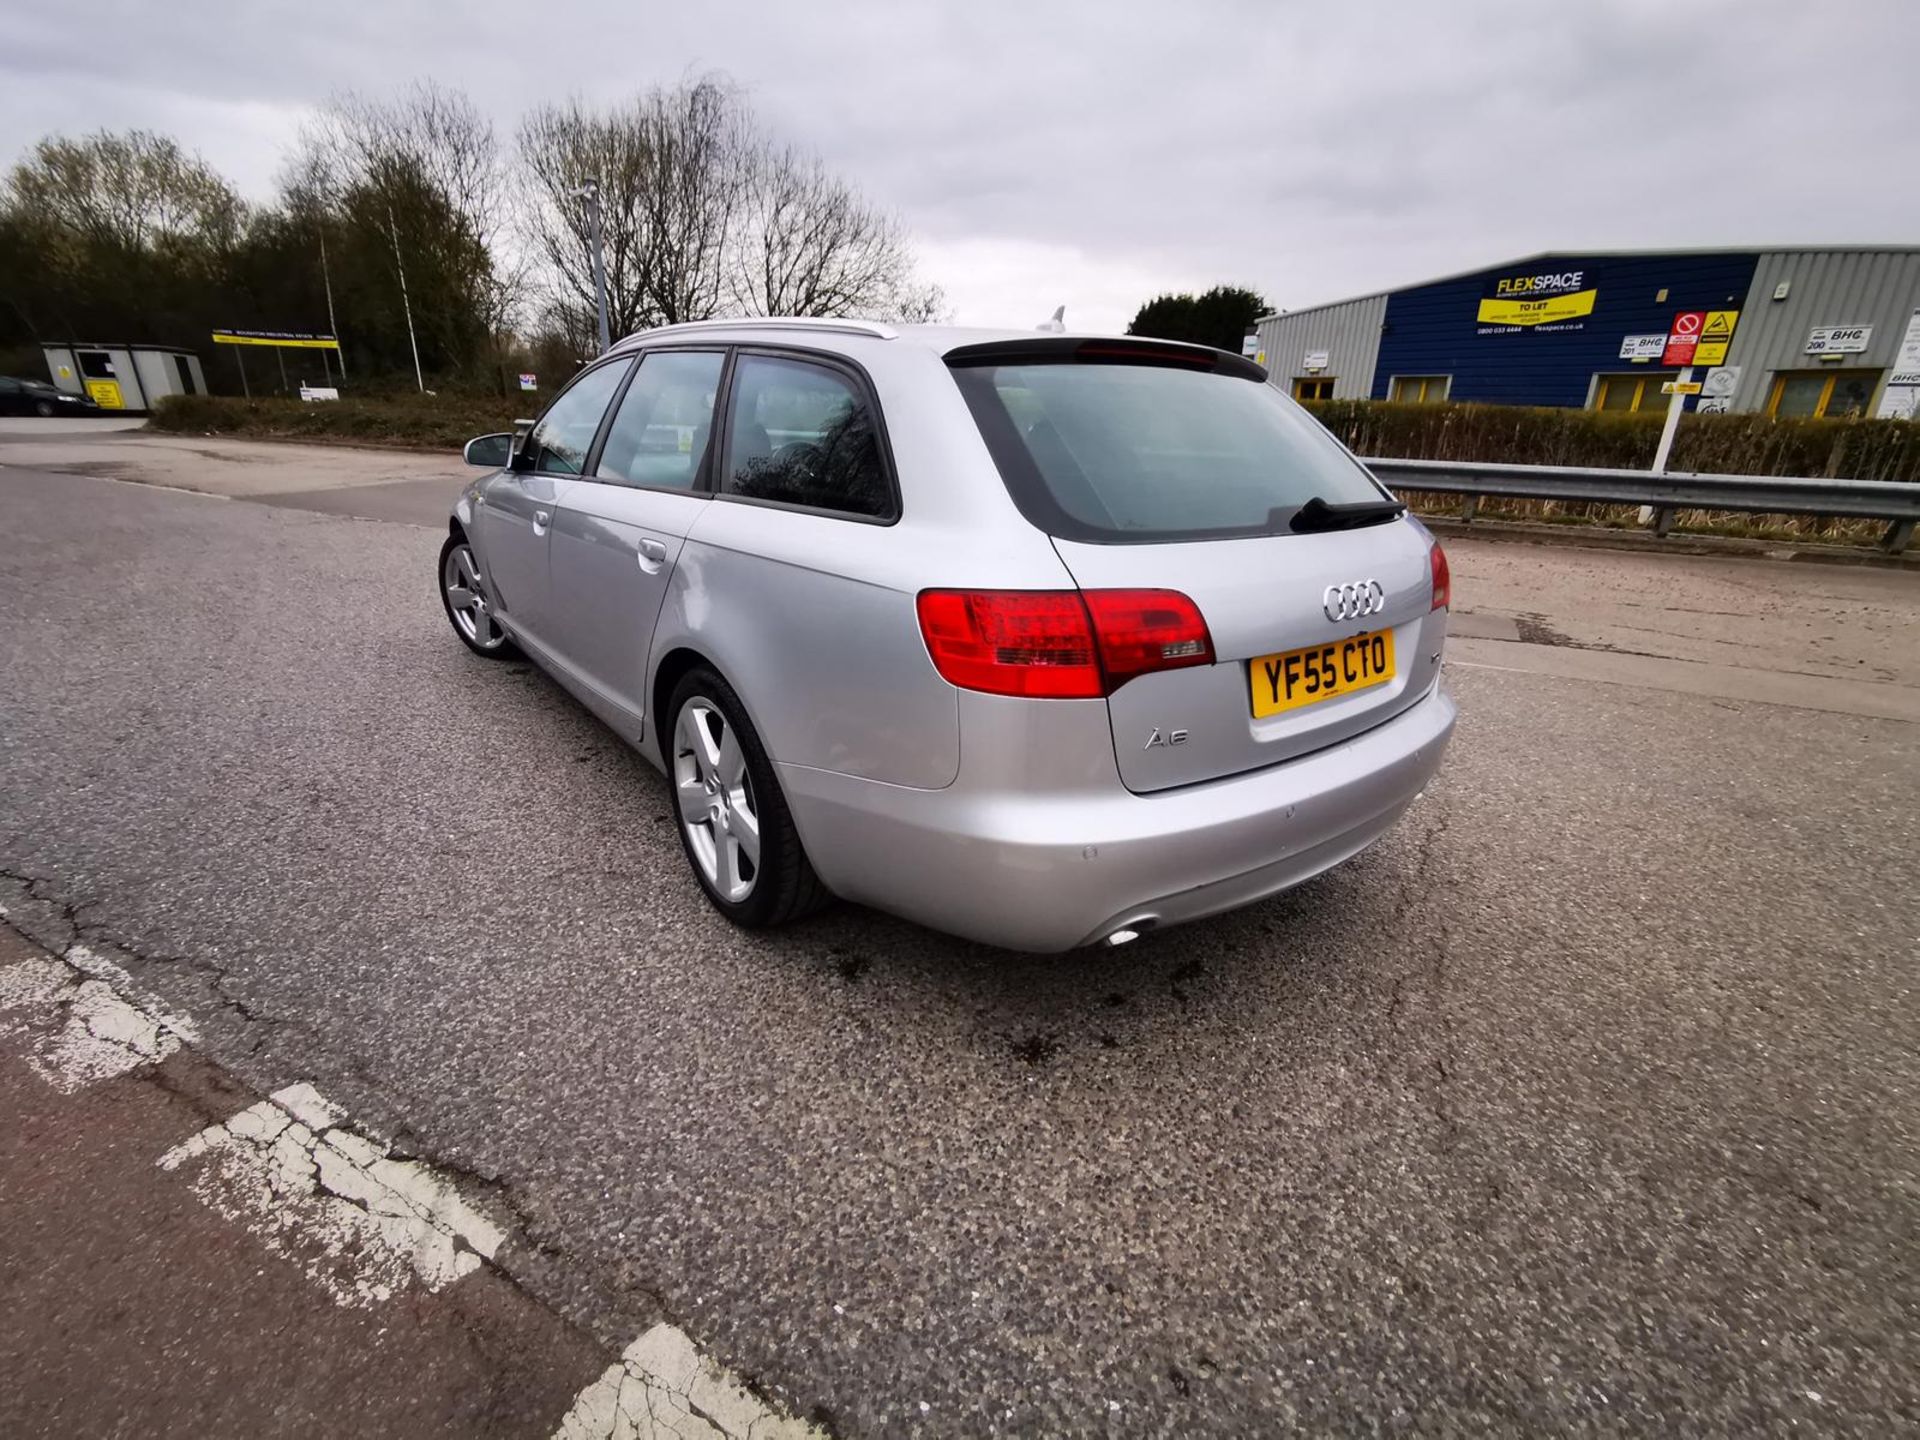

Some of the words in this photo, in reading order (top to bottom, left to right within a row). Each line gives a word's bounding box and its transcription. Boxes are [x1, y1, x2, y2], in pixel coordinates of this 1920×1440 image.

[1497, 271, 1584, 293] FLEXSPACE
[1519, 303, 1531, 311] TO
[1532, 302, 1548, 310] LET
[1477, 327, 1493, 335] 0800
[1830, 330, 1863, 341] BHC
[1638, 338, 1662, 347] BHC
[1807, 341, 1825, 350] 200
[1622, 347, 1635, 355] 201
[1264, 653, 1338, 704] YF55
[1343, 636, 1386, 683] CTO
[1144, 728, 1188, 750] A6
